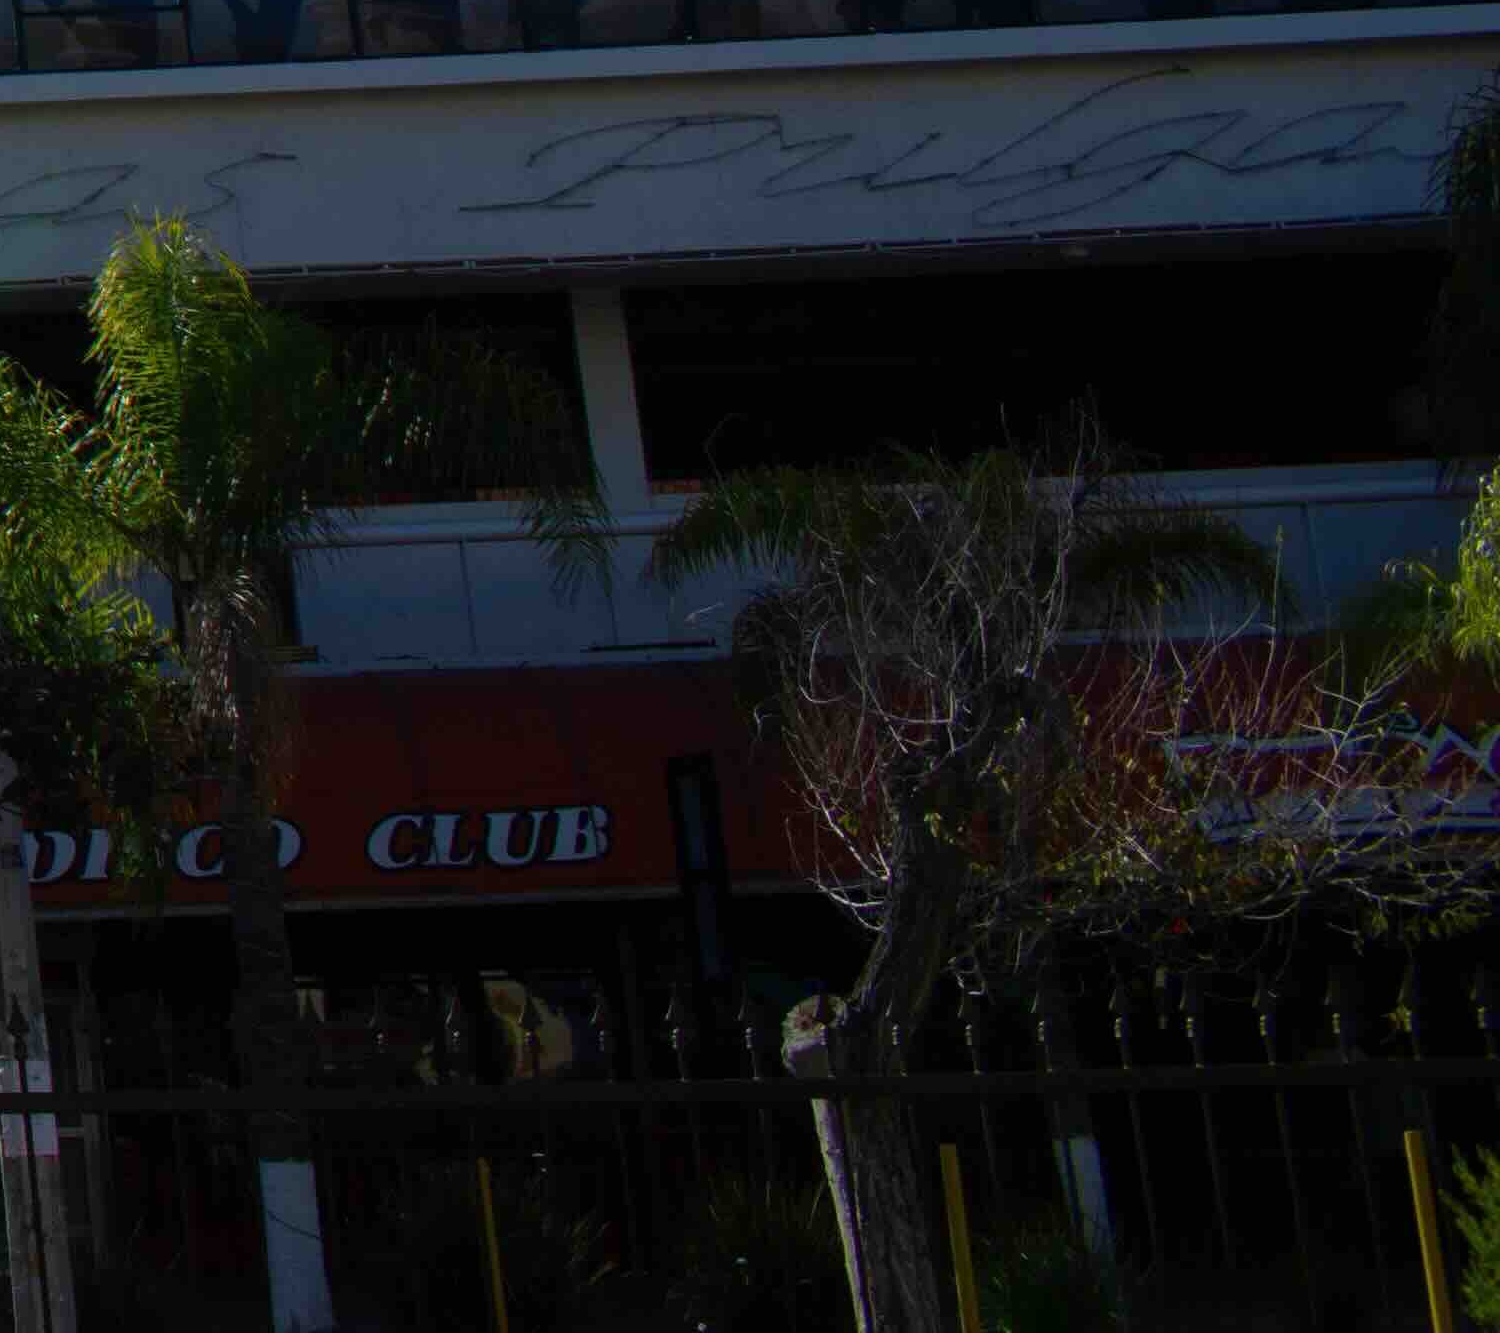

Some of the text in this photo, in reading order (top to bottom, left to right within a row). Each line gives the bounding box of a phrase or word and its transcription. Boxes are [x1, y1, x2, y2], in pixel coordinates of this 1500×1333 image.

[458, 64, 1447, 229] Pulga
[17, 804, 612, 884] DICO CLUB
